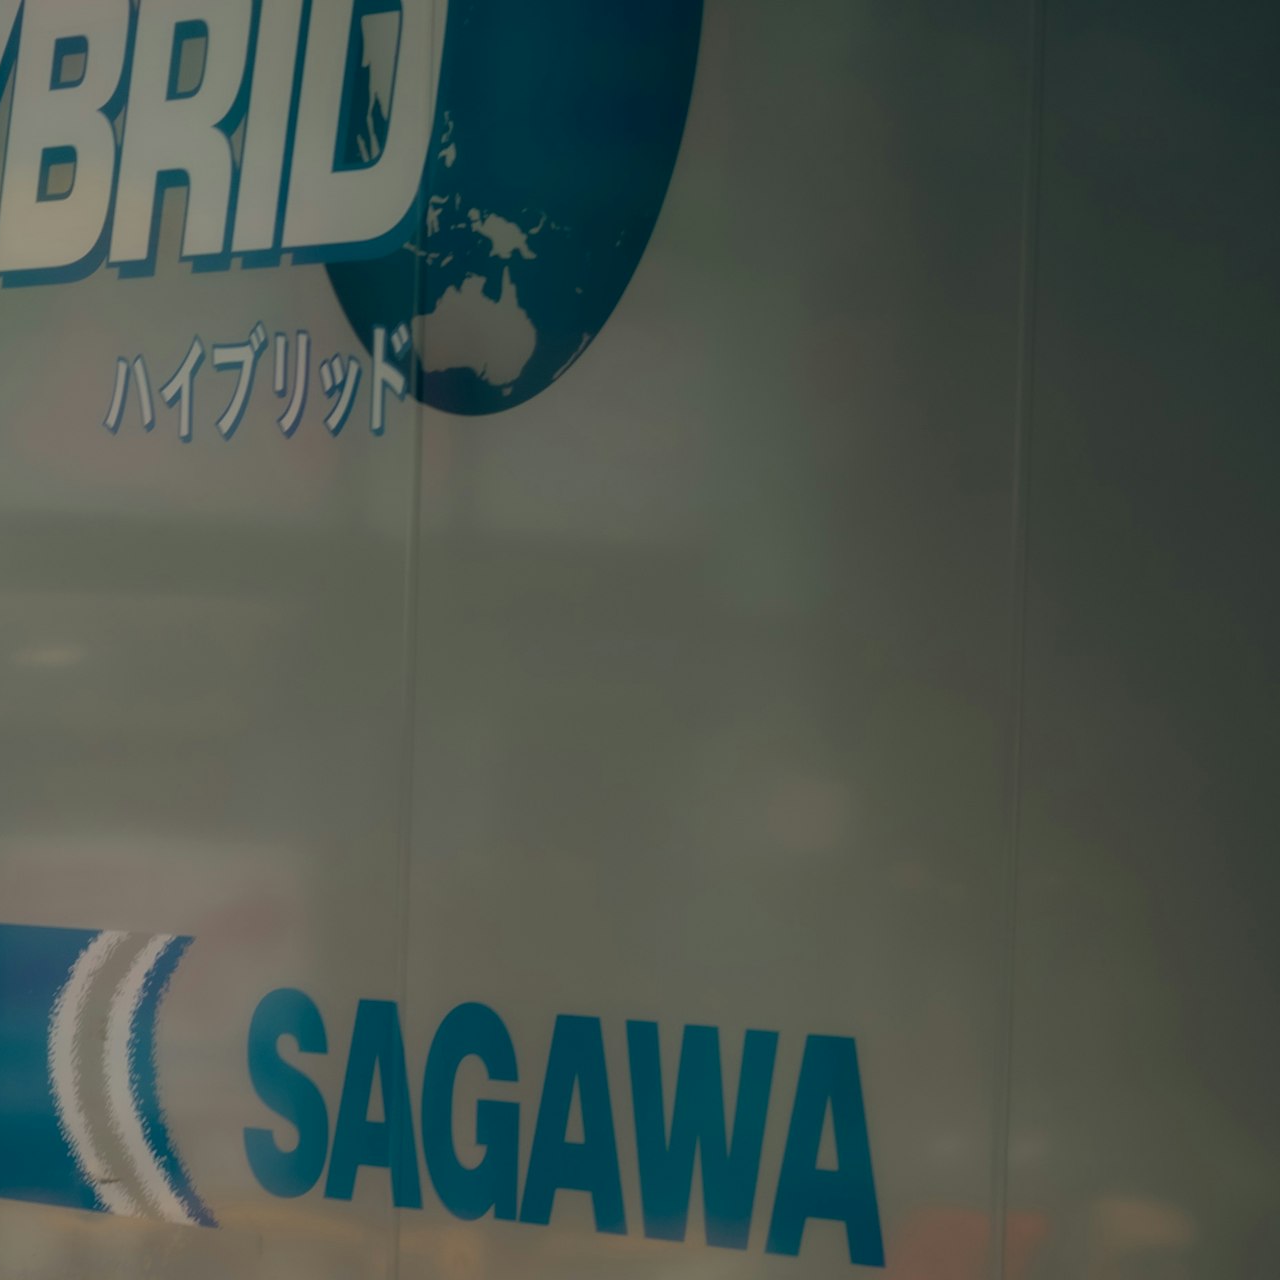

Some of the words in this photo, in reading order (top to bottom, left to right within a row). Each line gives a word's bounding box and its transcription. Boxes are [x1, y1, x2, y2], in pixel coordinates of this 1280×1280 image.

[102, 323, 414, 441] ハイブリッド
[242, 986, 887, 1268] SAGAWA
